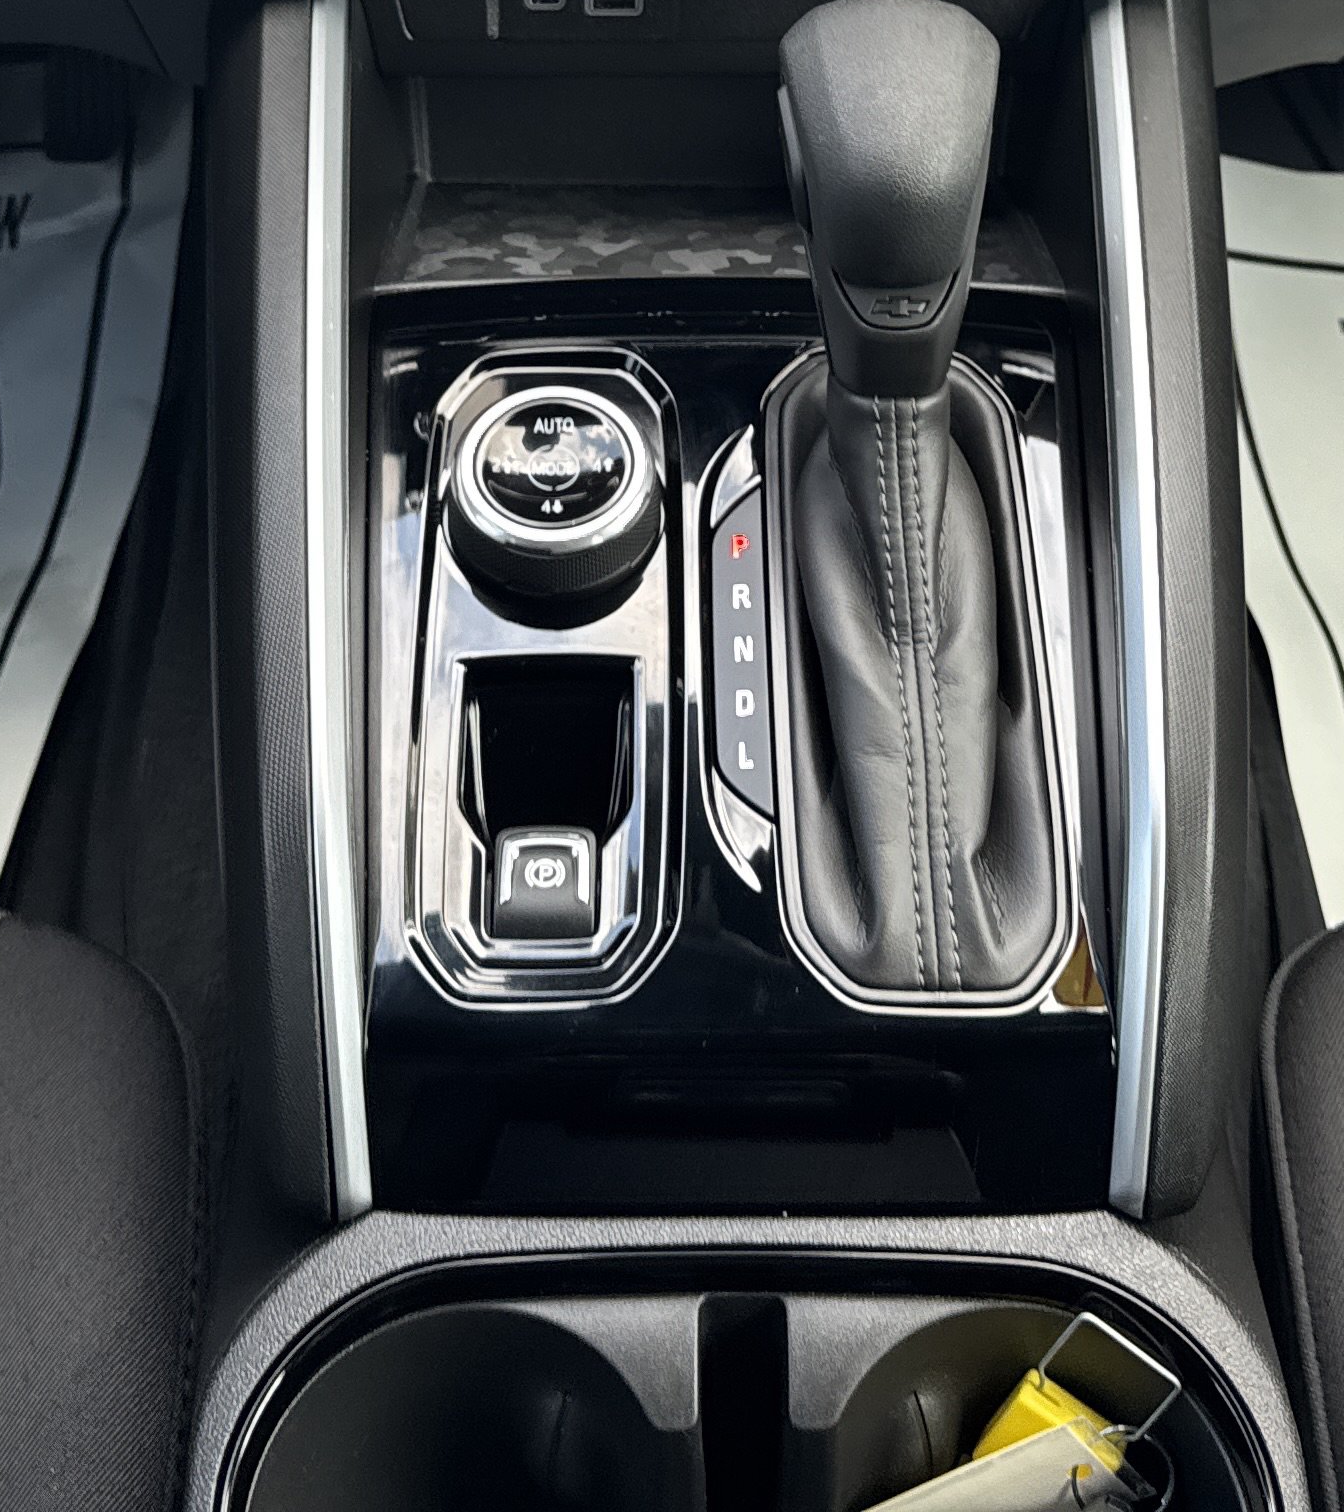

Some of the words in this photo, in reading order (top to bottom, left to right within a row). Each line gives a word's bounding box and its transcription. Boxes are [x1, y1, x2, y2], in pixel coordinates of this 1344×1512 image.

[534, 417, 575, 435] AUTO
[730, 533, 749, 558] P
[732, 584, 752, 609] R
[734, 636, 754, 662] N
[736, 690, 755, 717] D
[738, 742, 754, 769] L
